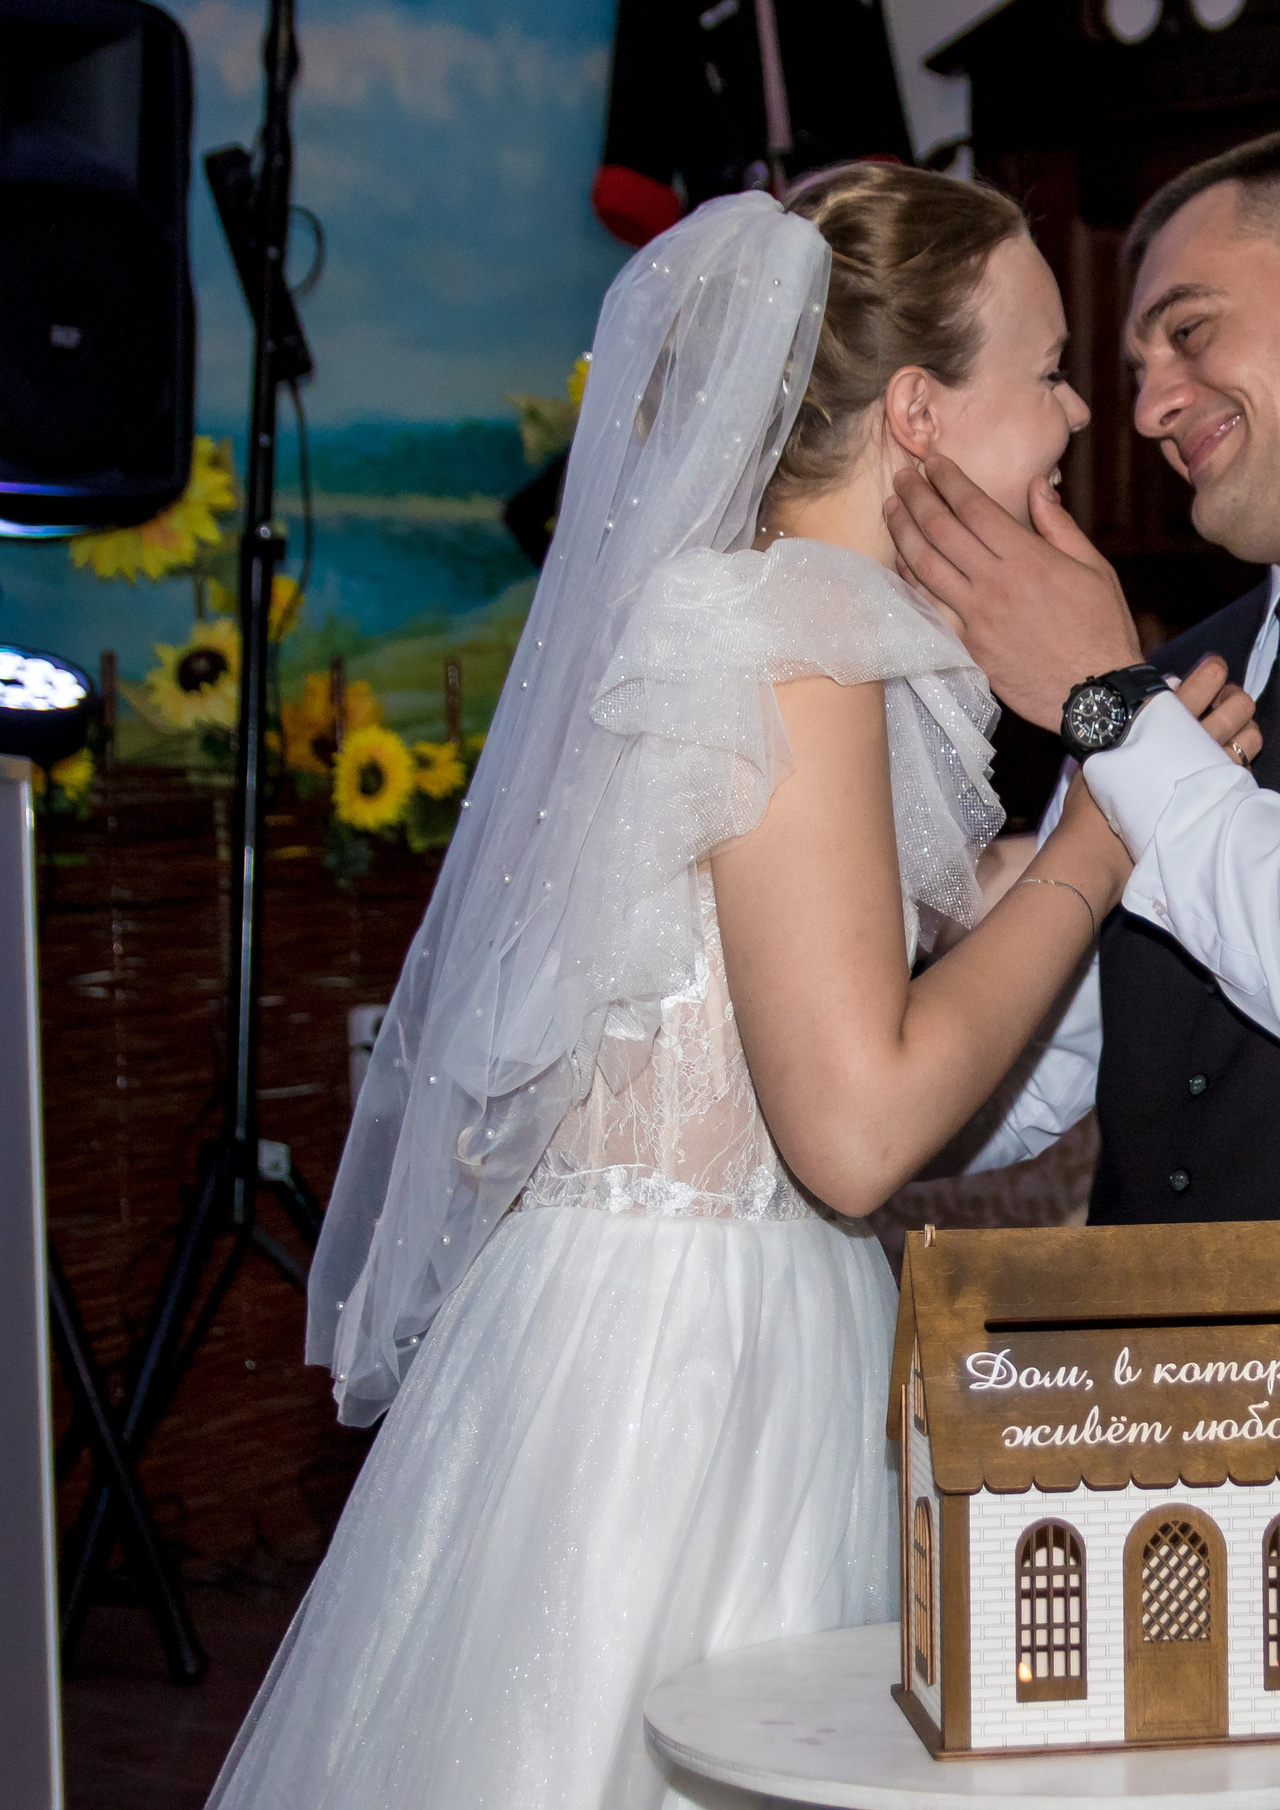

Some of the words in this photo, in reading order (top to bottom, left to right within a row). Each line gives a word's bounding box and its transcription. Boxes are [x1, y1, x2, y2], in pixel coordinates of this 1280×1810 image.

[965, 1348, 1094, 1391] Дом,
[1113, 1346, 1142, 1386] в
[1001, 1404, 1173, 1448] живёт
